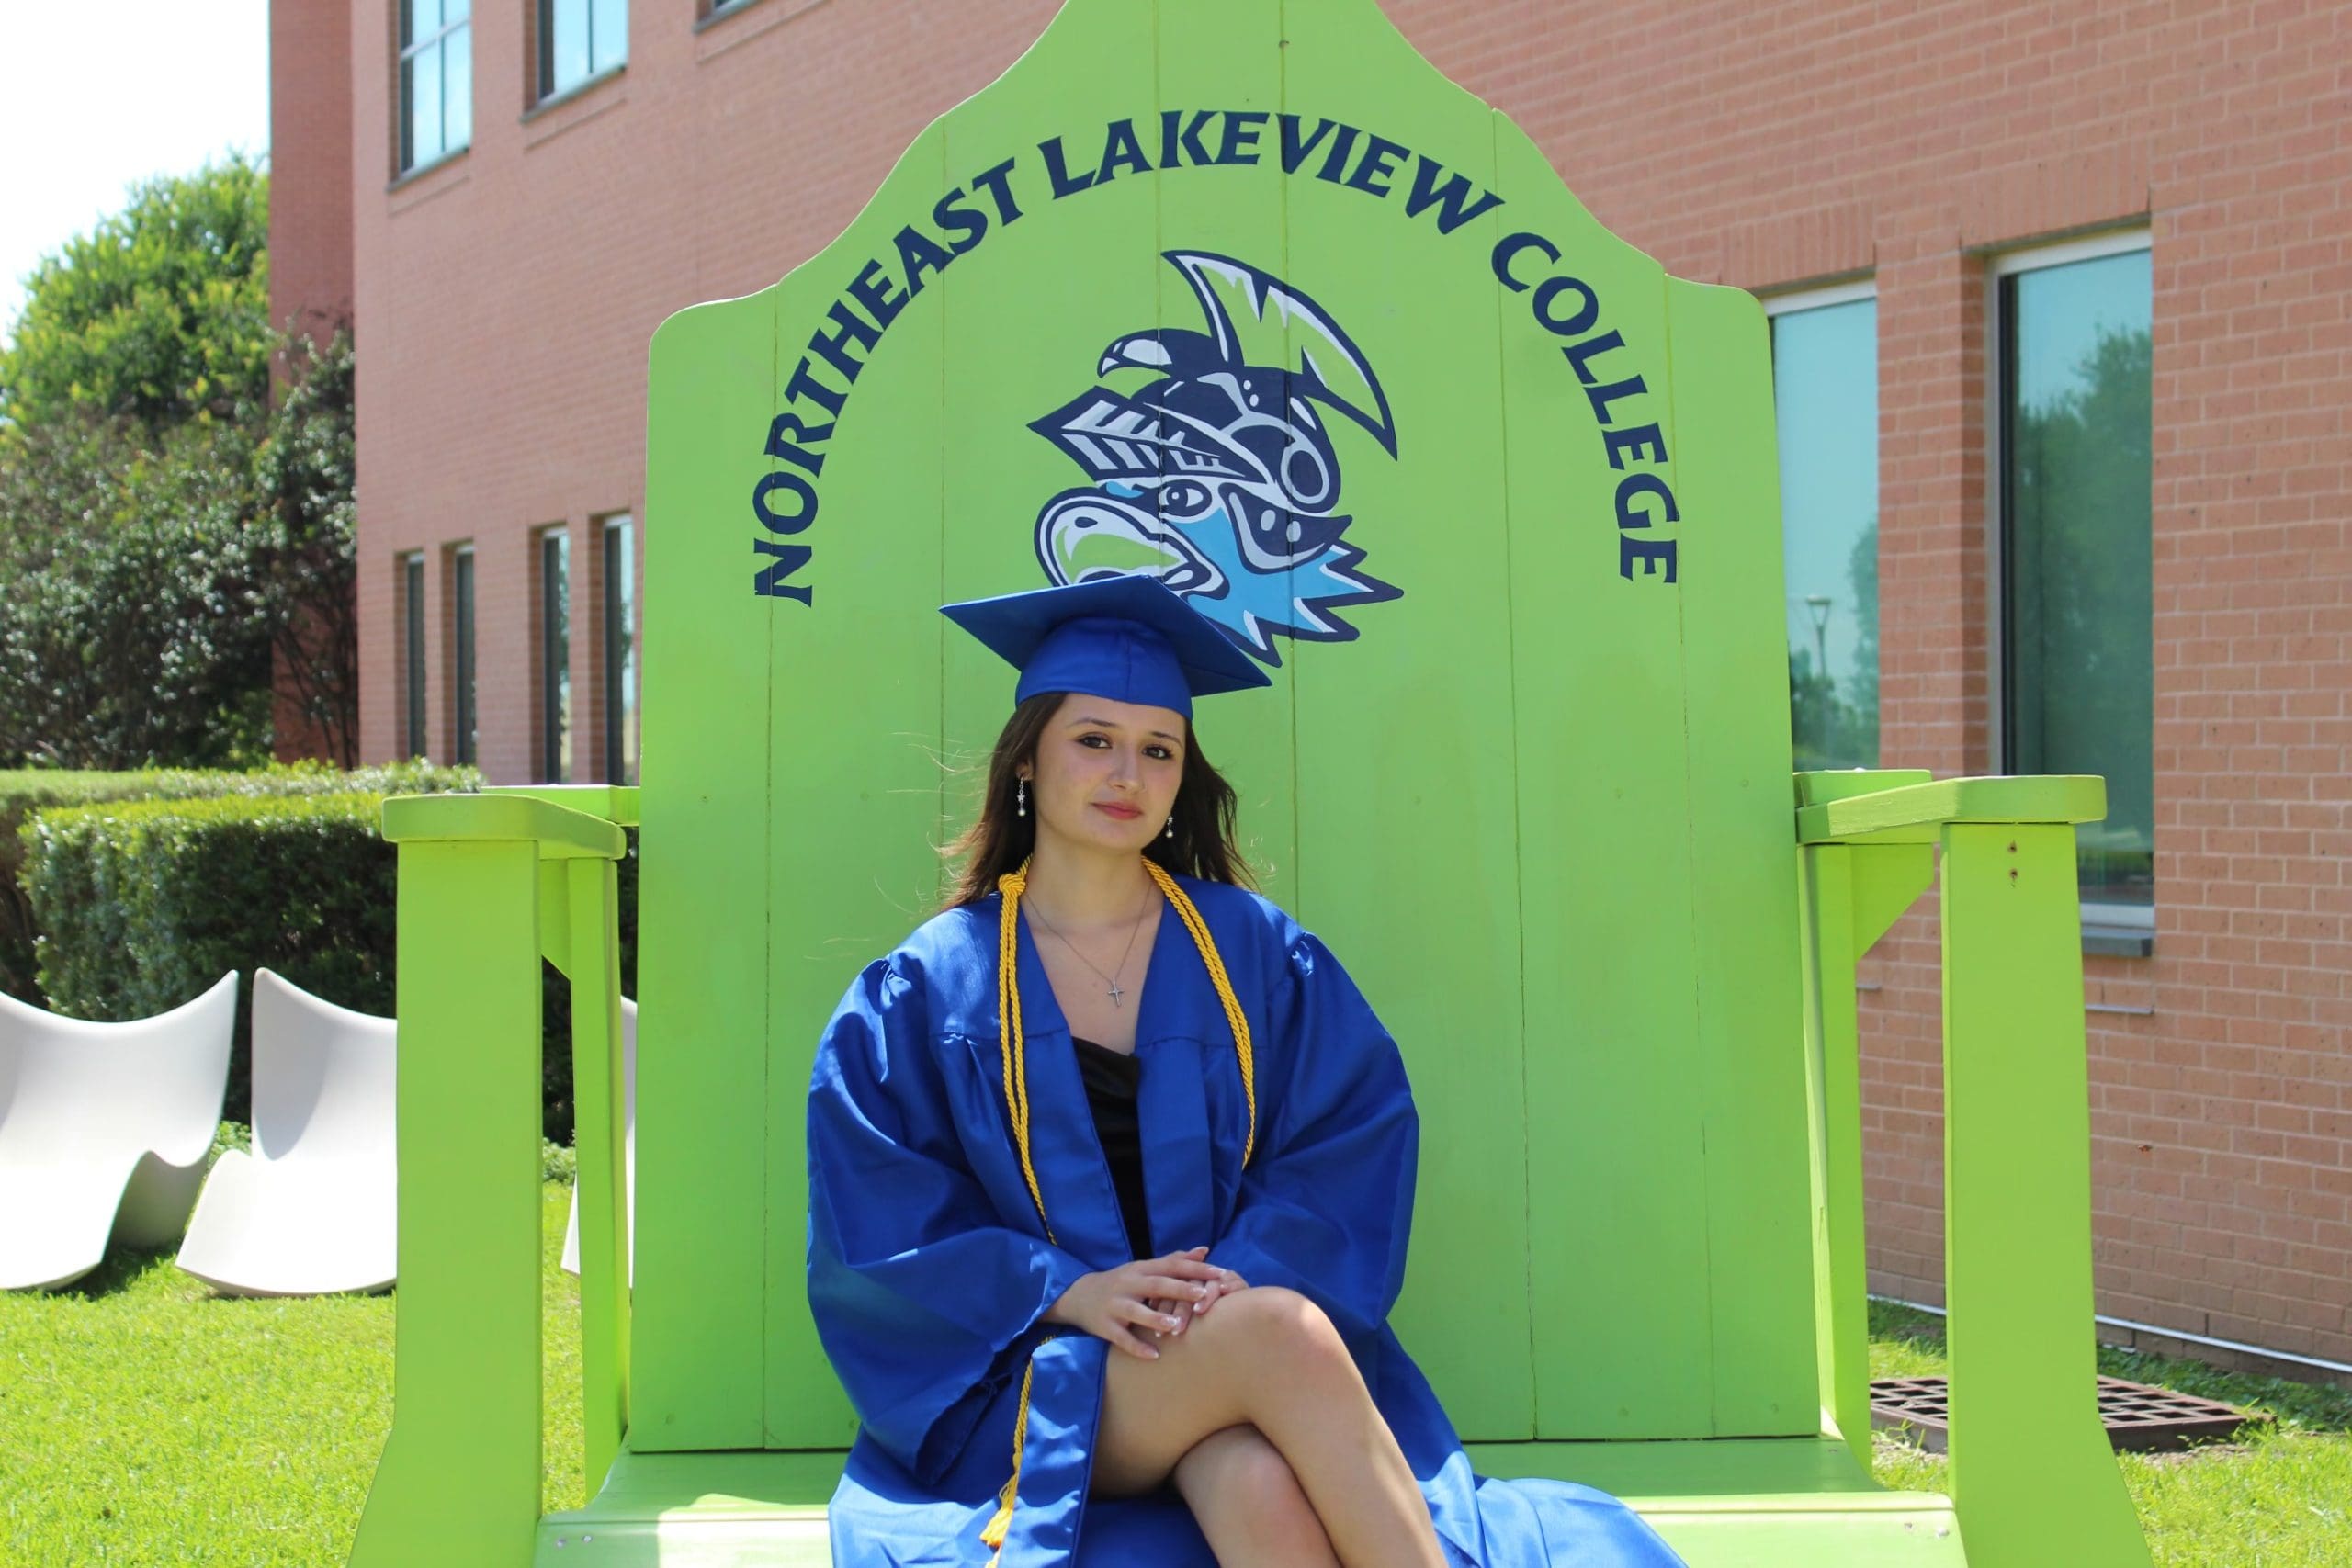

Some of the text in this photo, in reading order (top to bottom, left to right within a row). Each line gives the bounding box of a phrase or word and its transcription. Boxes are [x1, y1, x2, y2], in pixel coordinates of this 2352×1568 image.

[752, 110, 1680, 608] NORTHEAST LAKEVIEW COLLEGE
